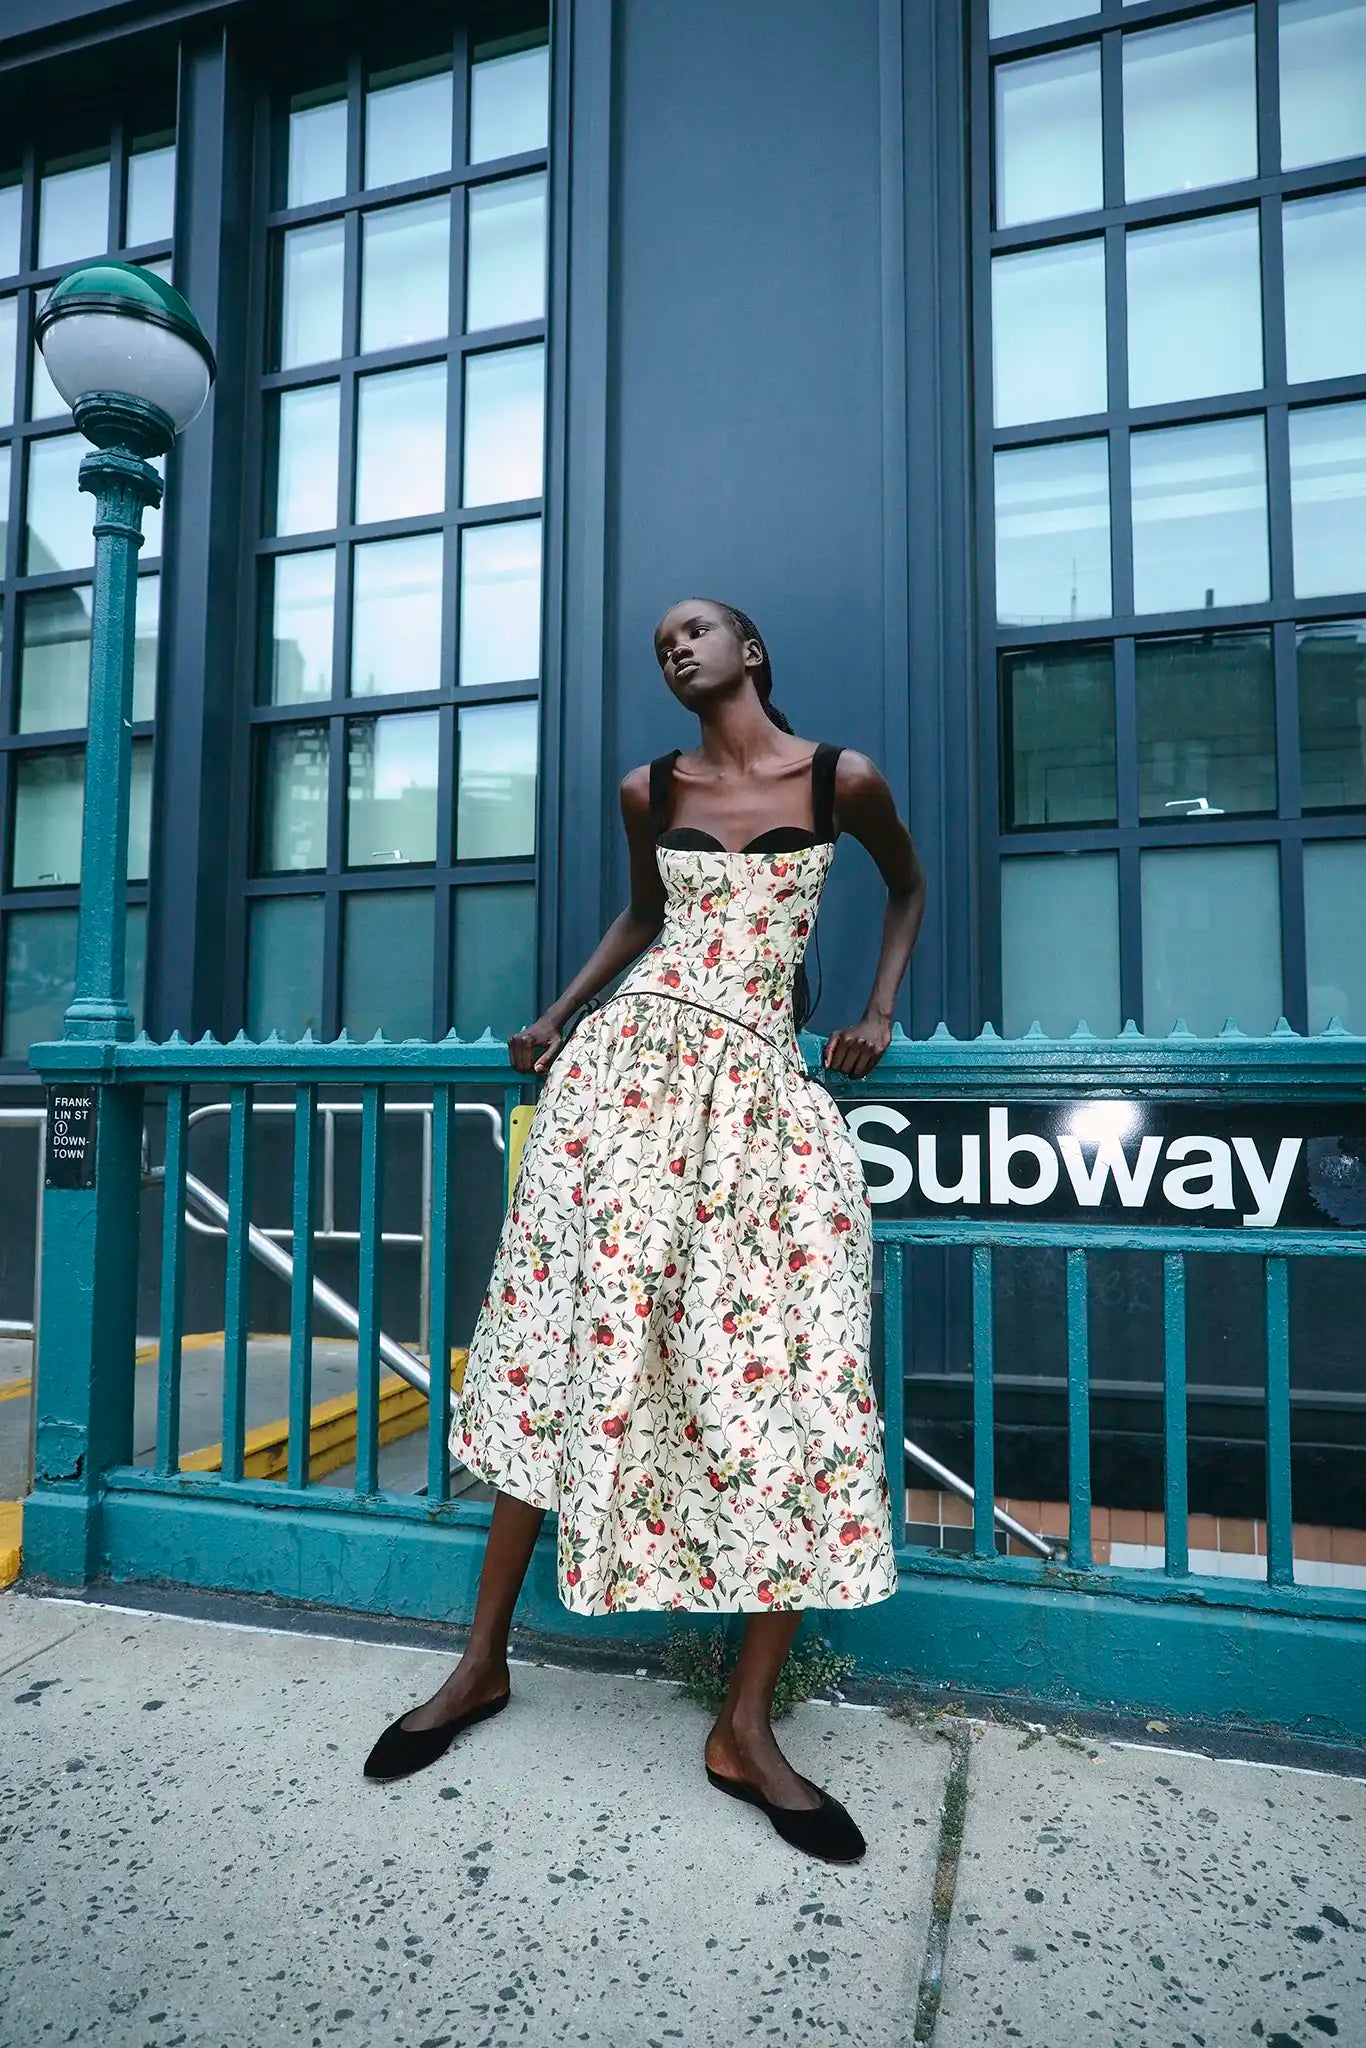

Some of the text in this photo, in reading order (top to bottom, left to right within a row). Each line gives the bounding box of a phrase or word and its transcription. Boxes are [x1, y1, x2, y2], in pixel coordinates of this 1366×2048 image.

[54, 1097, 92, 1107] FRANK-
[54, 1110, 89, 1120] LIN ST
[53, 1136, 90, 1146] DOWN-
[53, 1149, 84, 1159] TOWN
[845, 1105, 1304, 1228] Subway
